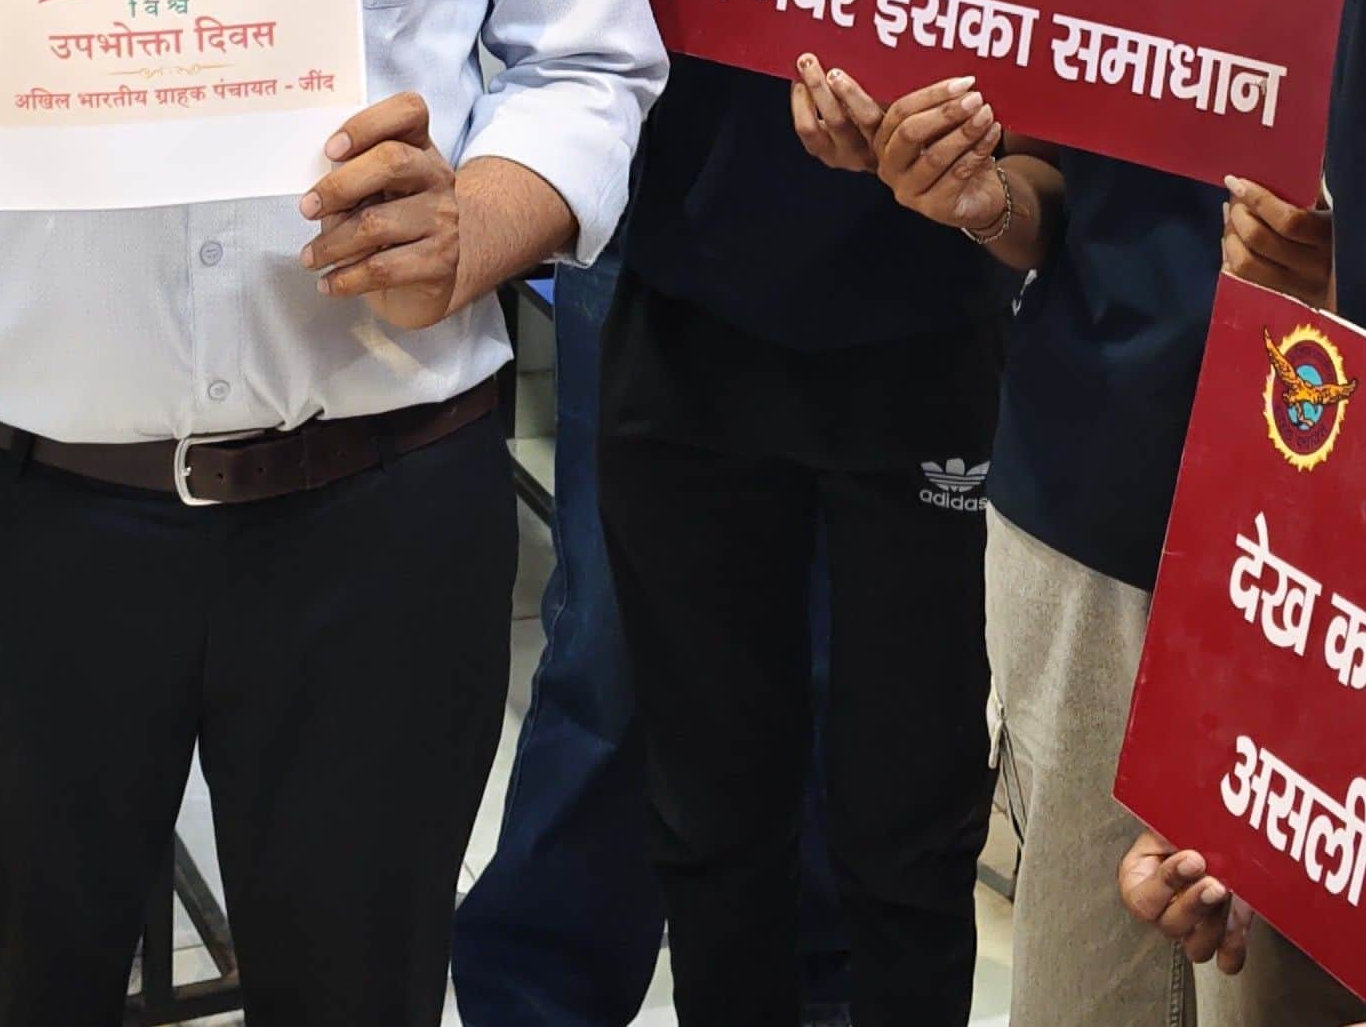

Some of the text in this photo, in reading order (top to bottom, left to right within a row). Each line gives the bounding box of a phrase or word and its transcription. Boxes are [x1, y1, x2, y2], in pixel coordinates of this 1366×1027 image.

[49, 16, 277, 61] उपभोक्ता दिवस
[14, 87, 71, 111] अखिल
[77, 84, 148, 109] भारतीय
[154, 84, 206, 108] ग्राहक
[212, 77, 278, 100] पंचायत
[299, 69, 336, 93] जींद
[1051, 13, 1287, 127] समाधान
[919, 489, 987, 512] adidas
[1229, 511, 1323, 656] देख
